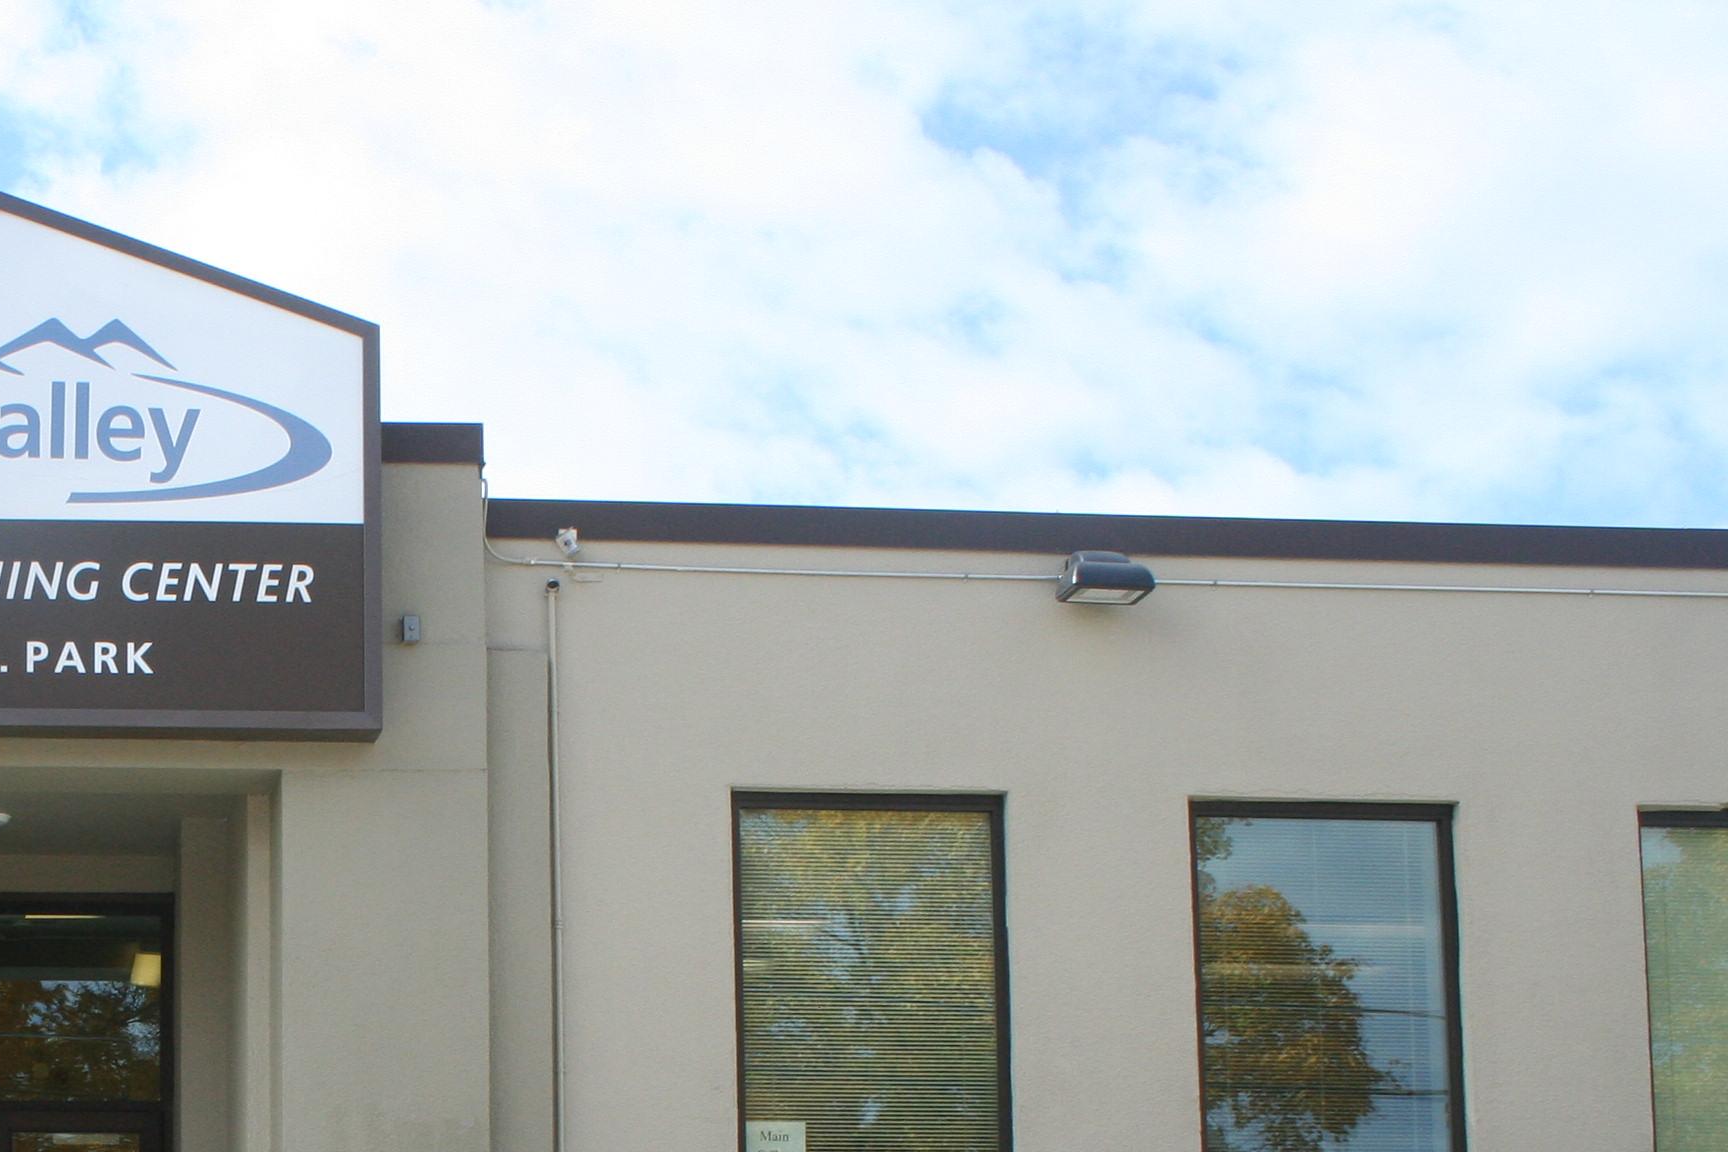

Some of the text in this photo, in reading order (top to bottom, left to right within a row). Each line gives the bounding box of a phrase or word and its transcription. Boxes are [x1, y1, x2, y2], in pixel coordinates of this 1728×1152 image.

[121, 561, 314, 603] CENTER
[26, 640, 154, 675] PARK
[759, 1129, 789, 1142] Main
